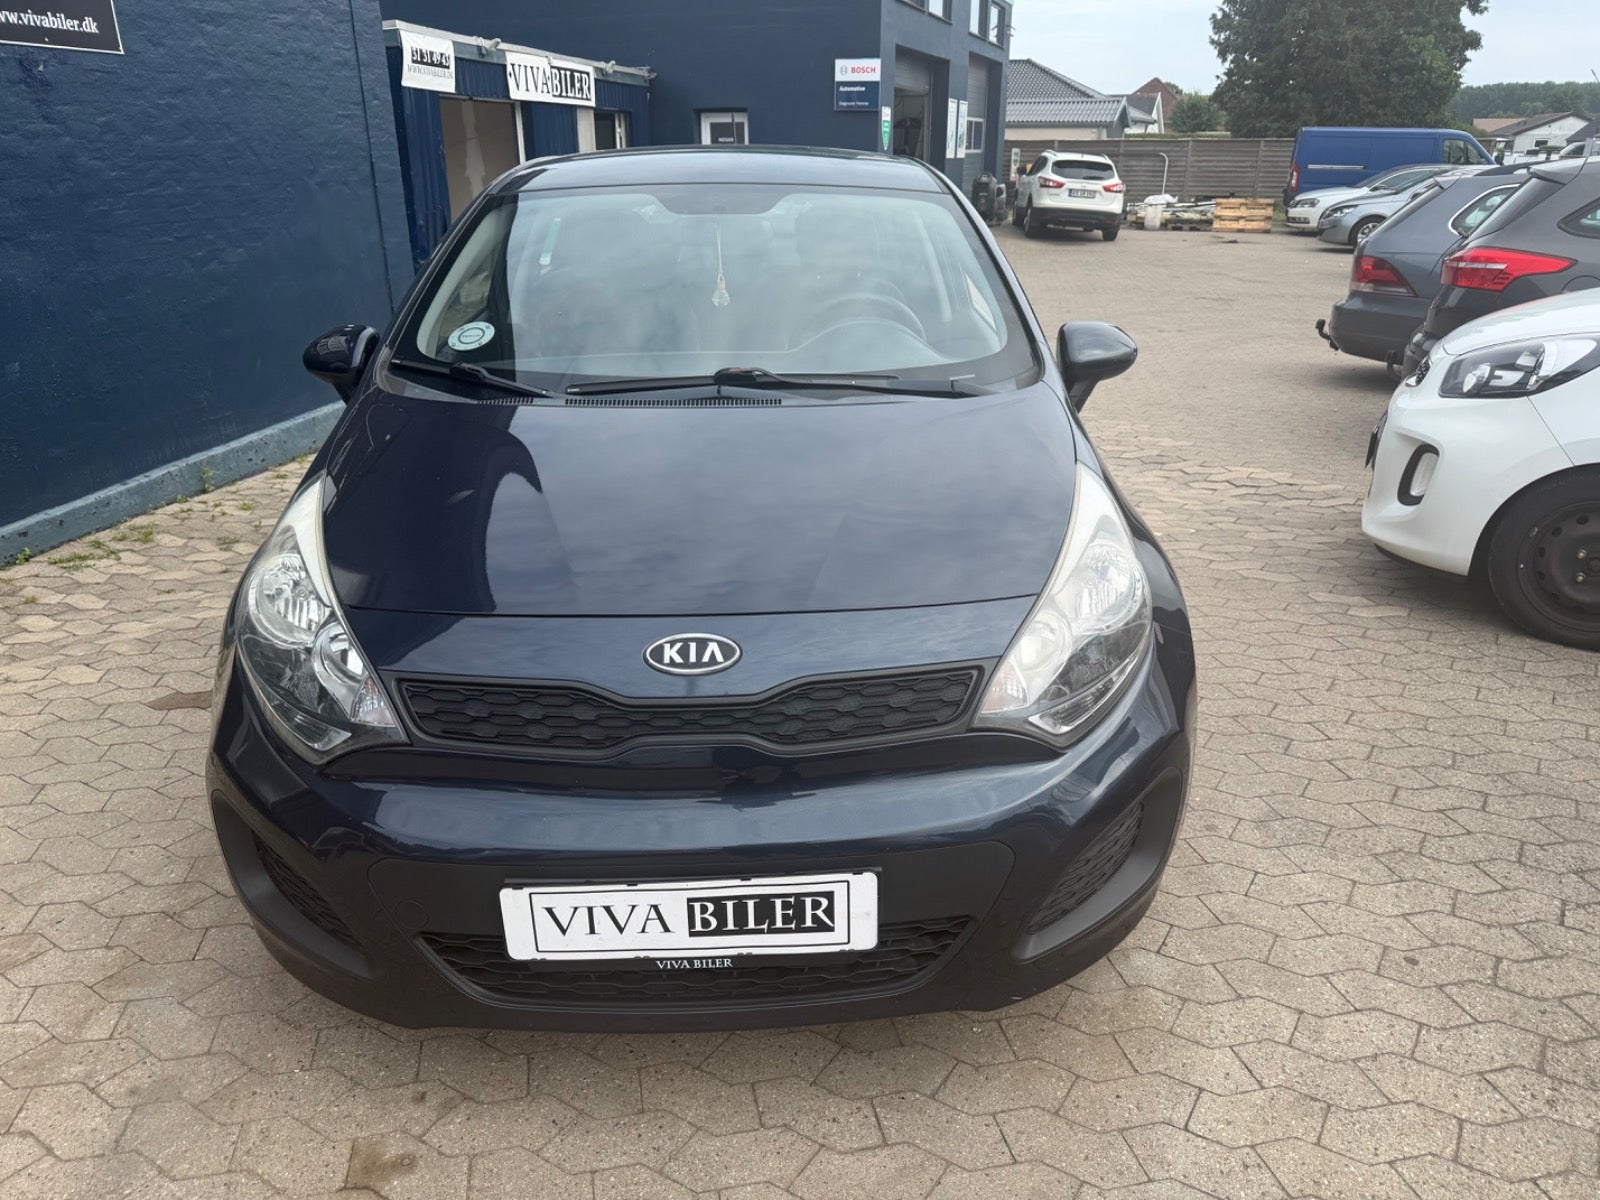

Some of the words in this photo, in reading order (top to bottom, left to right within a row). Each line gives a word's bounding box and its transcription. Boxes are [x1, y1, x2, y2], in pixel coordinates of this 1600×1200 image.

[510, 63, 550, 94] VIVA
[551, 67, 590, 99] BILER
[851, 66, 876, 74] BOSCH
[663, 641, 725, 664] KIA
[541, 903, 676, 936] VIVA
[687, 895, 836, 934] BILER
[656, 960, 691, 970] VIVA
[693, 958, 734, 969] BILER
